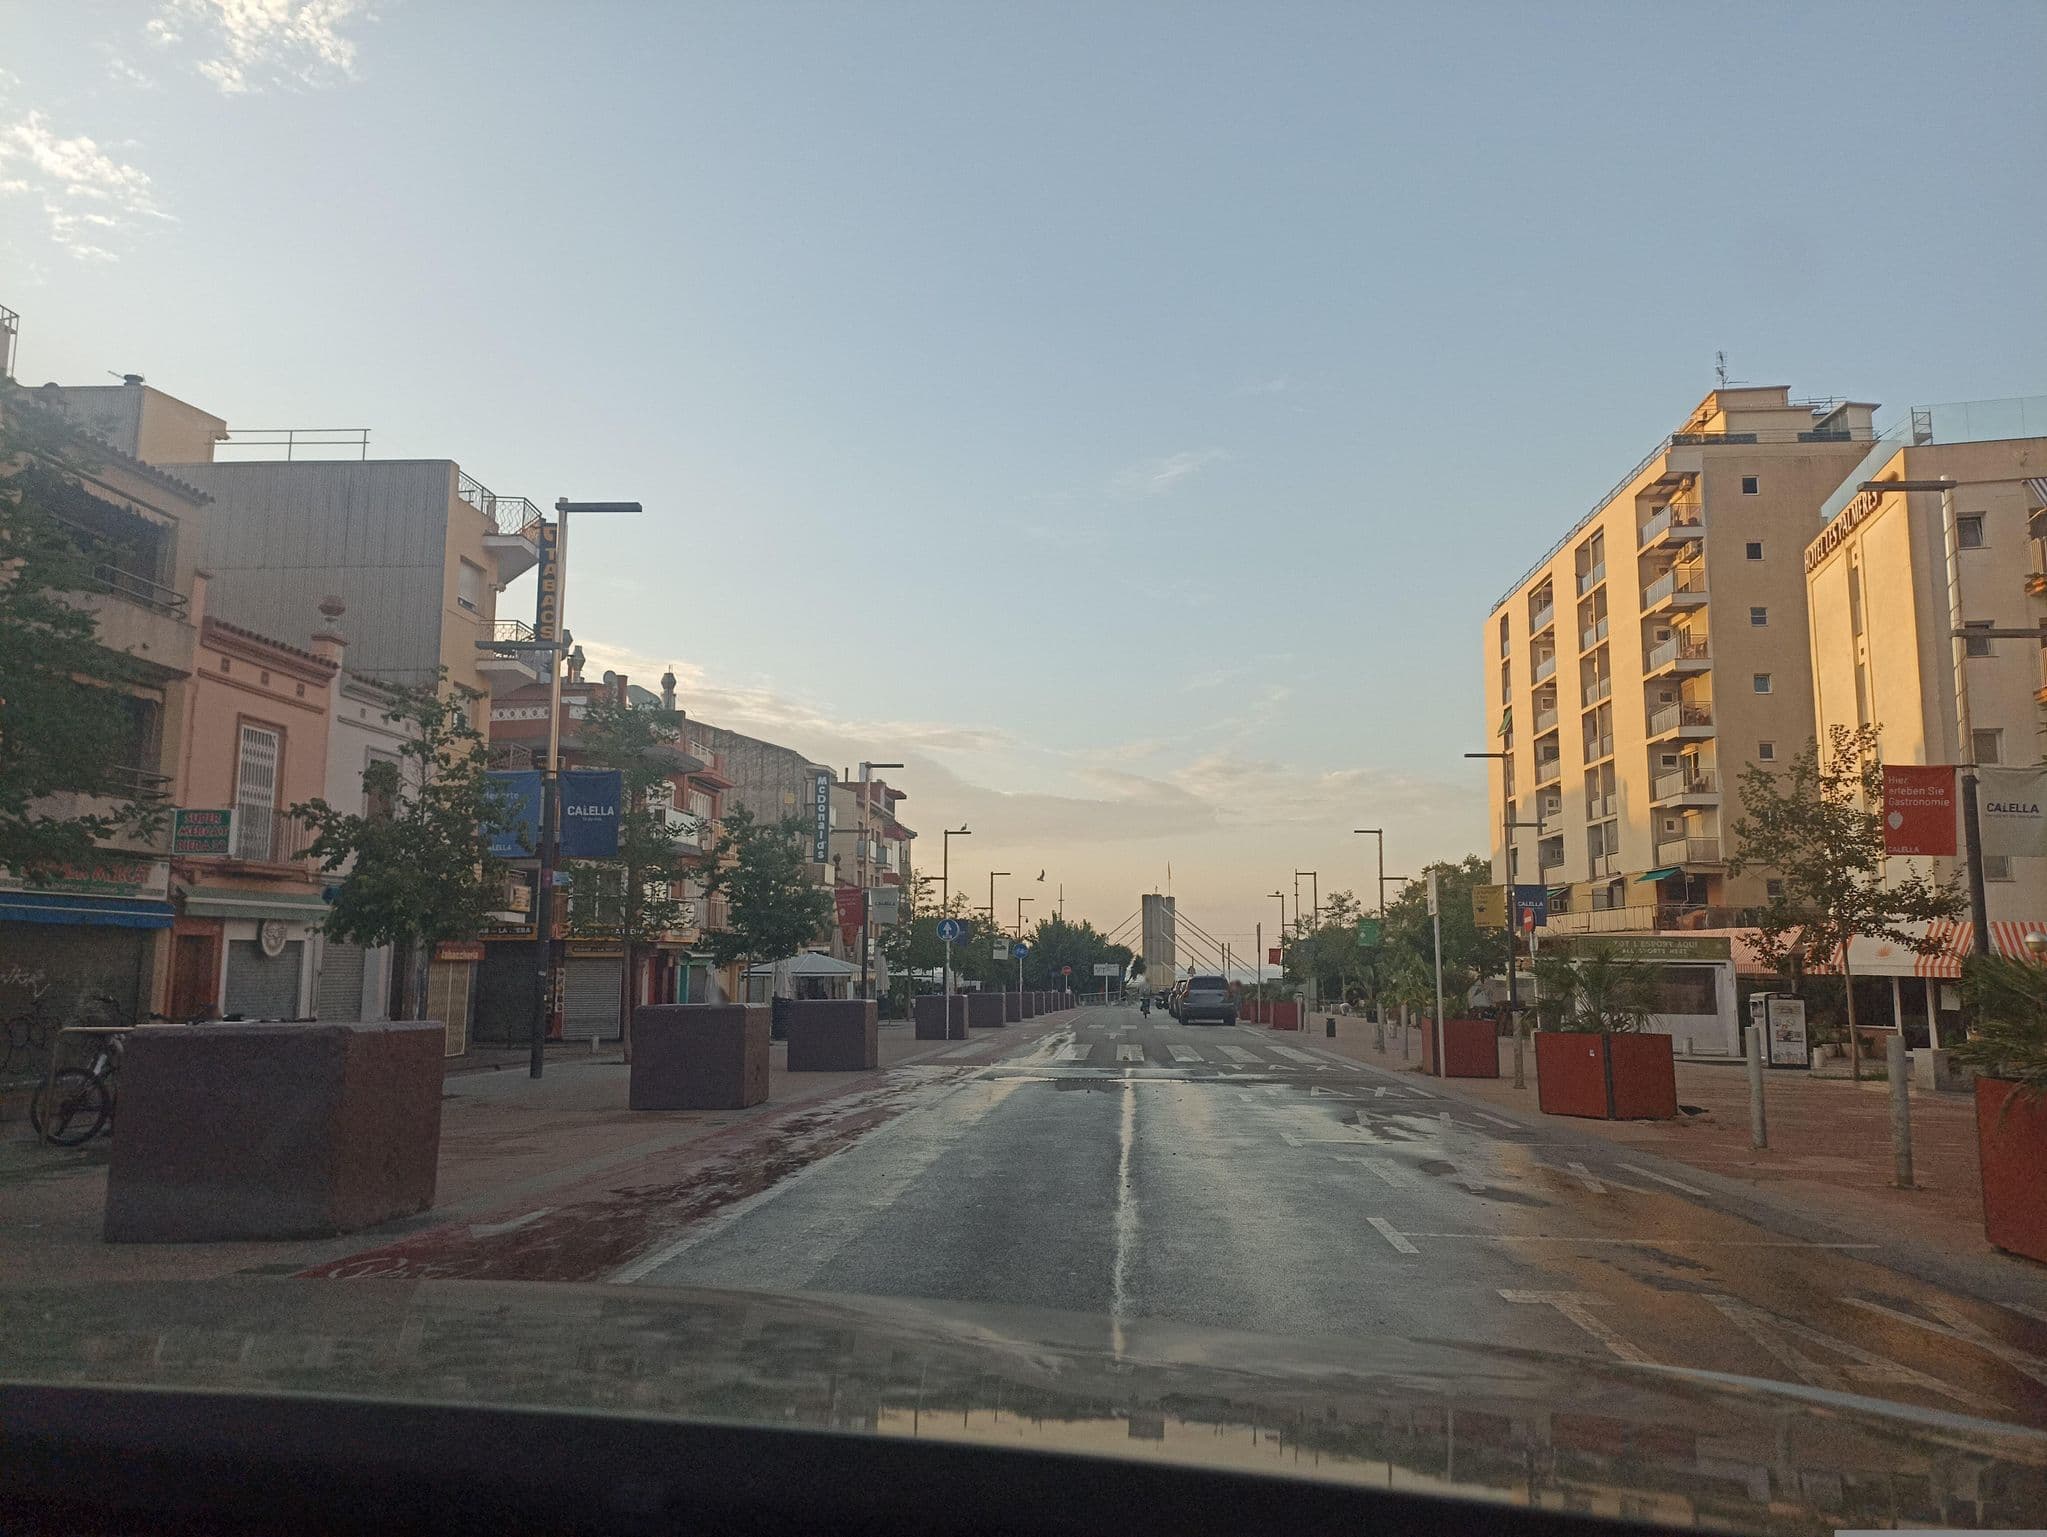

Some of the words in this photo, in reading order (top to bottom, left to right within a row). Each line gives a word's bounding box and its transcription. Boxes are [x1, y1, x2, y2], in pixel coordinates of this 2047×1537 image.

[540, 548, 557, 641] TABACS
[1888, 787, 1926, 796] erleben
[1927, 786, 1945, 796] Sie
[1888, 798, 1950, 807] Gastronomie
[1986, 802, 2039, 814] CALELLA
[567, 804, 615, 816] CALELLA
[817, 776, 828, 859] McDonald's
